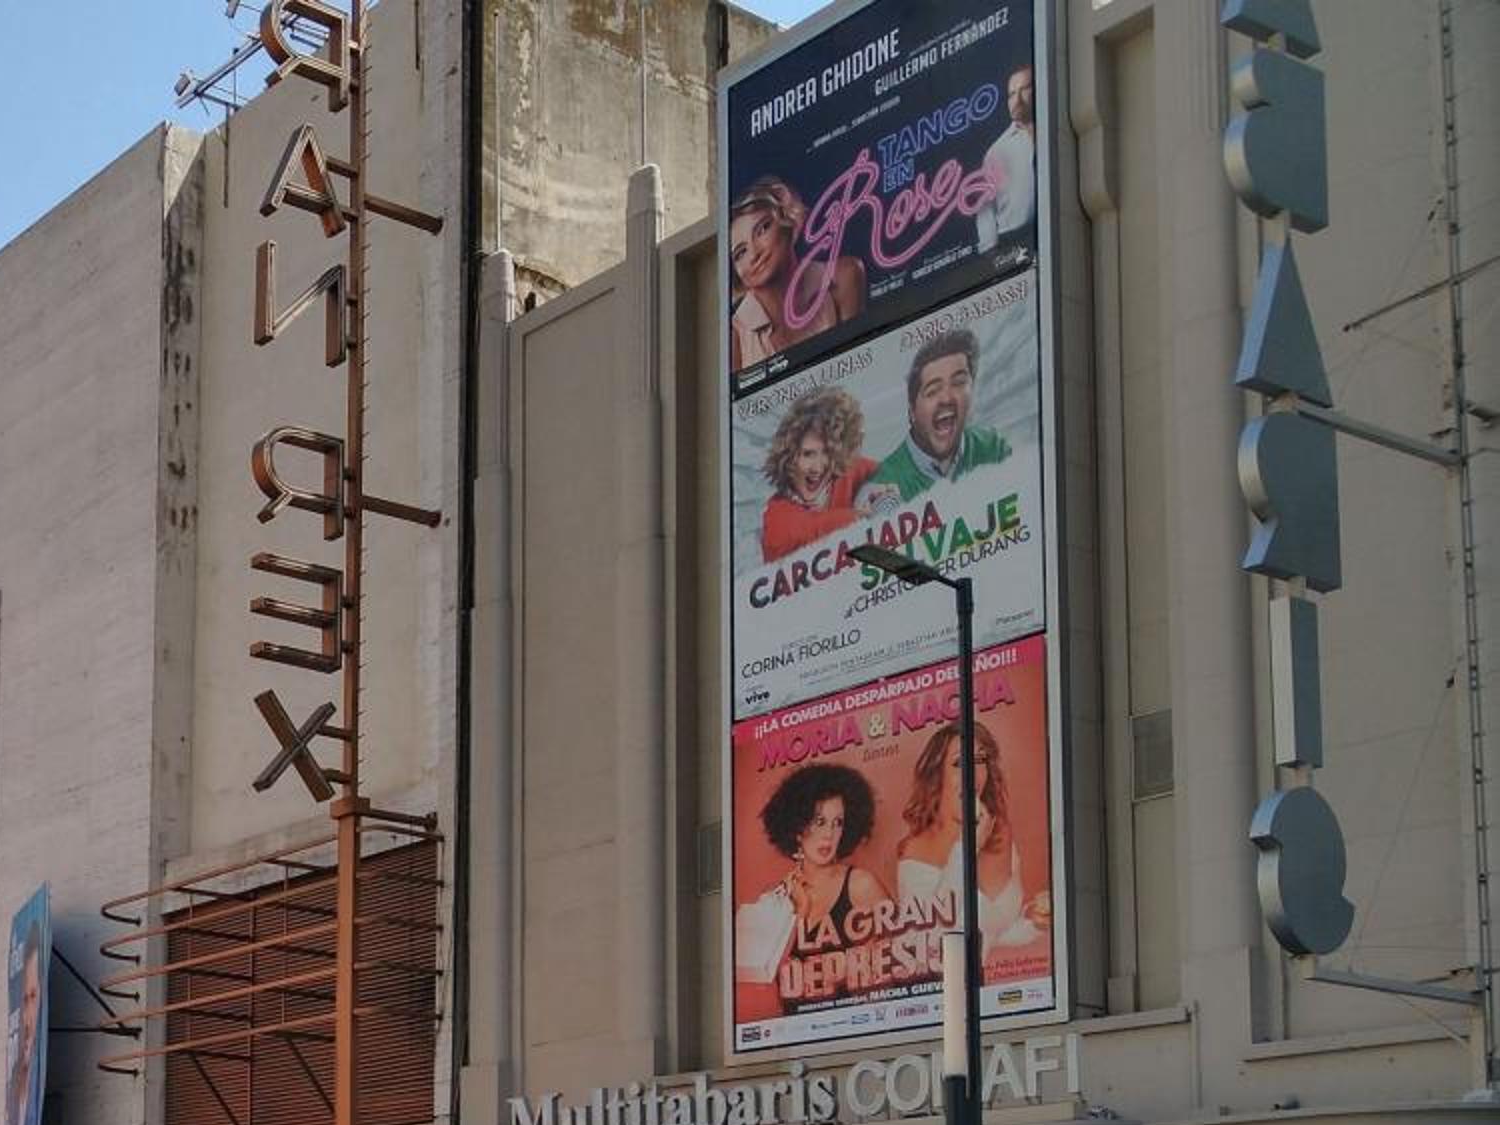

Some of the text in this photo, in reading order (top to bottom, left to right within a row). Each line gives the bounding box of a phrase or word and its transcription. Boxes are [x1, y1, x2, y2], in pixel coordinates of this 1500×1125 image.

[751, 78, 817, 137] ANDREA
[821, 28, 900, 97] GHIDONE
[875, 47, 938, 96] GUILLERMO
[877, 83, 999, 167] TANGO
[883, 158, 915, 193] EN
[853, 524, 1031, 613] CHRISTOER DURANG
[861, 493, 1021, 591] SVAJE
[741, 650, 795, 679] CORINA
[799, 629, 861, 661] FIORILLO
[757, 674, 1016, 773] MORIA & NACA
[781, 702, 842, 728] COMEDIA
[845, 675, 932, 709] DESPARPAJO
[935, 667, 961, 684] DEL
[798, 890, 959, 951] LA GRAN
[778, 930, 945, 999] DEPRESI
[846, 1032, 1082, 1118] COAFI
